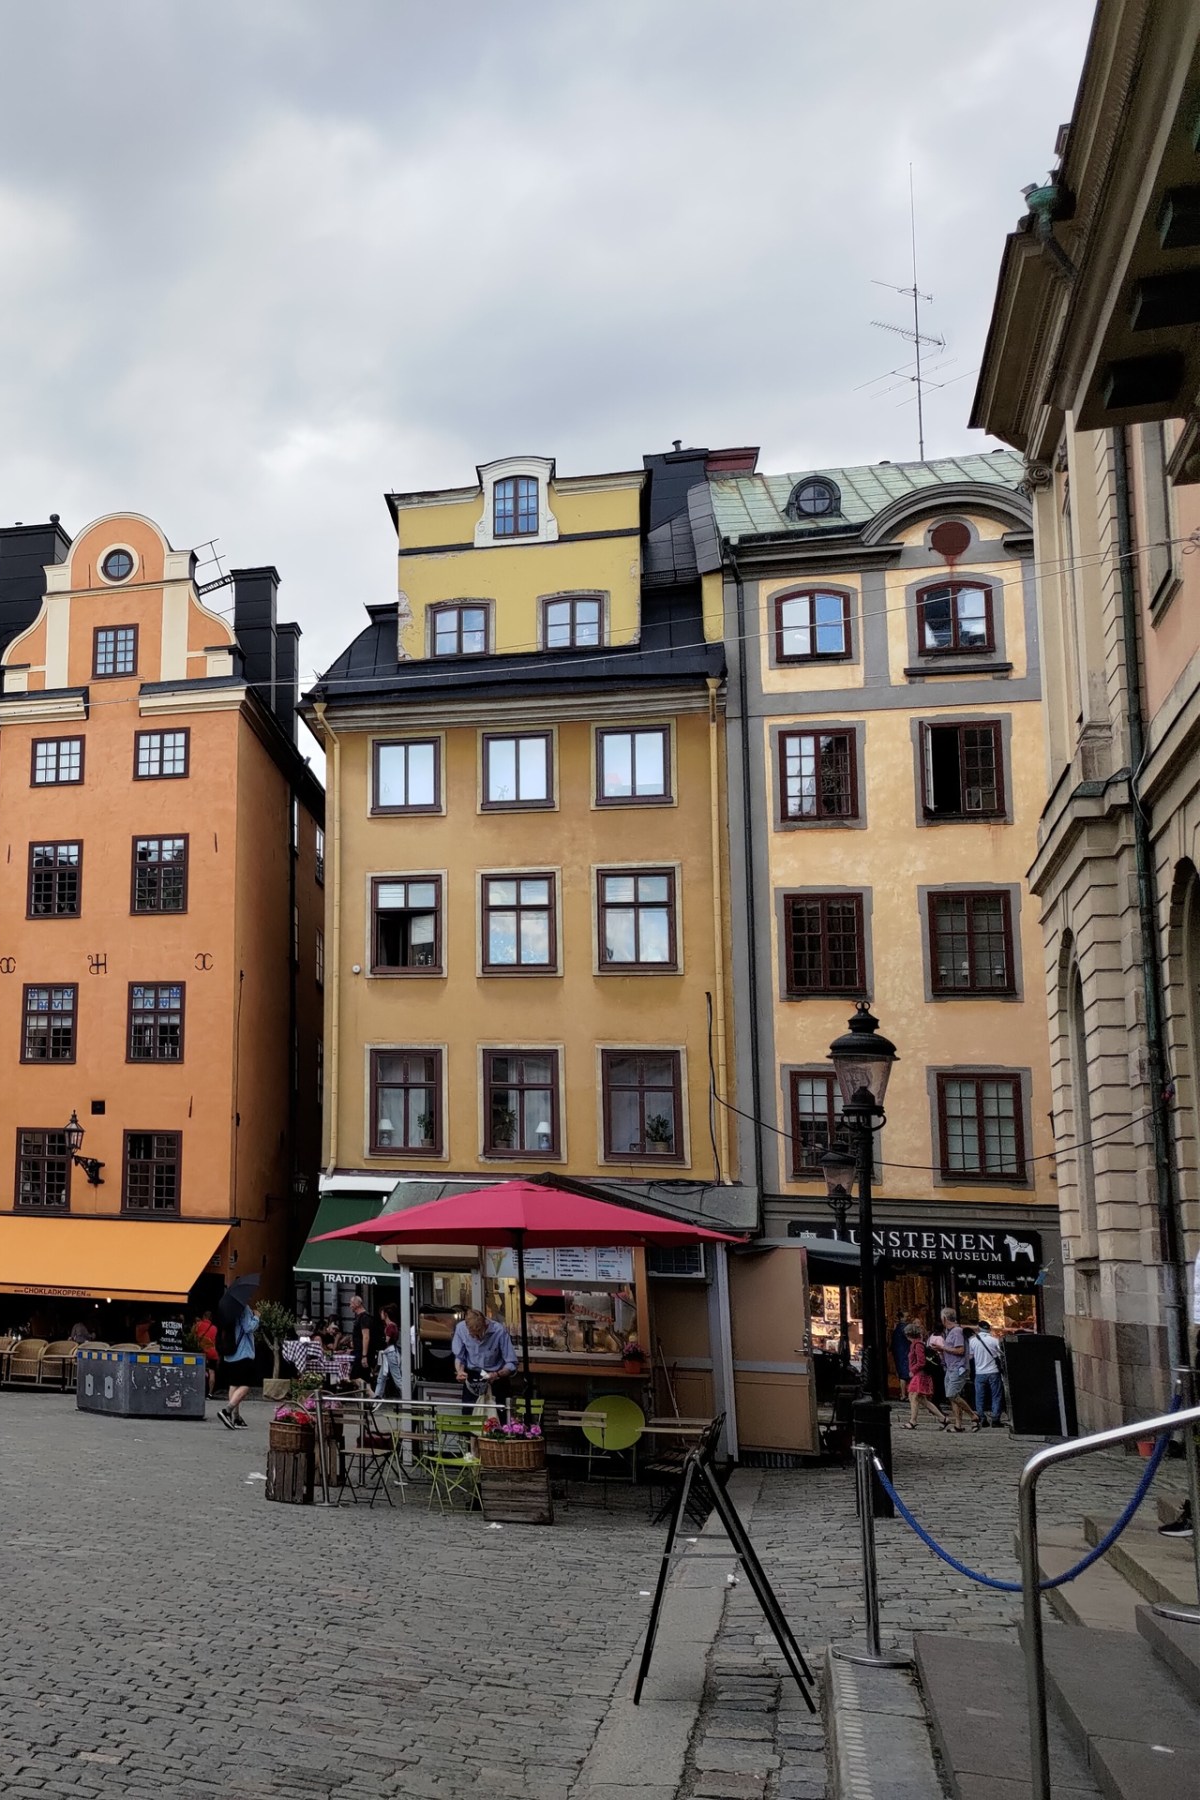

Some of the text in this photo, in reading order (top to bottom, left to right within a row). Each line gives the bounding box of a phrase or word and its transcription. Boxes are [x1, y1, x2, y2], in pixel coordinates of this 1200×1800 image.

[832, 1228, 996, 1251] UNSTENEN
[892, 1248, 937, 1259] HORSE
[942, 1251, 1002, 1262] MUSEUM
[322, 1273, 378, 1285] TRATTORIA
[987, 1273, 1005, 1281] FREE
[978, 1279, 1016, 1288] ENTRANCE
